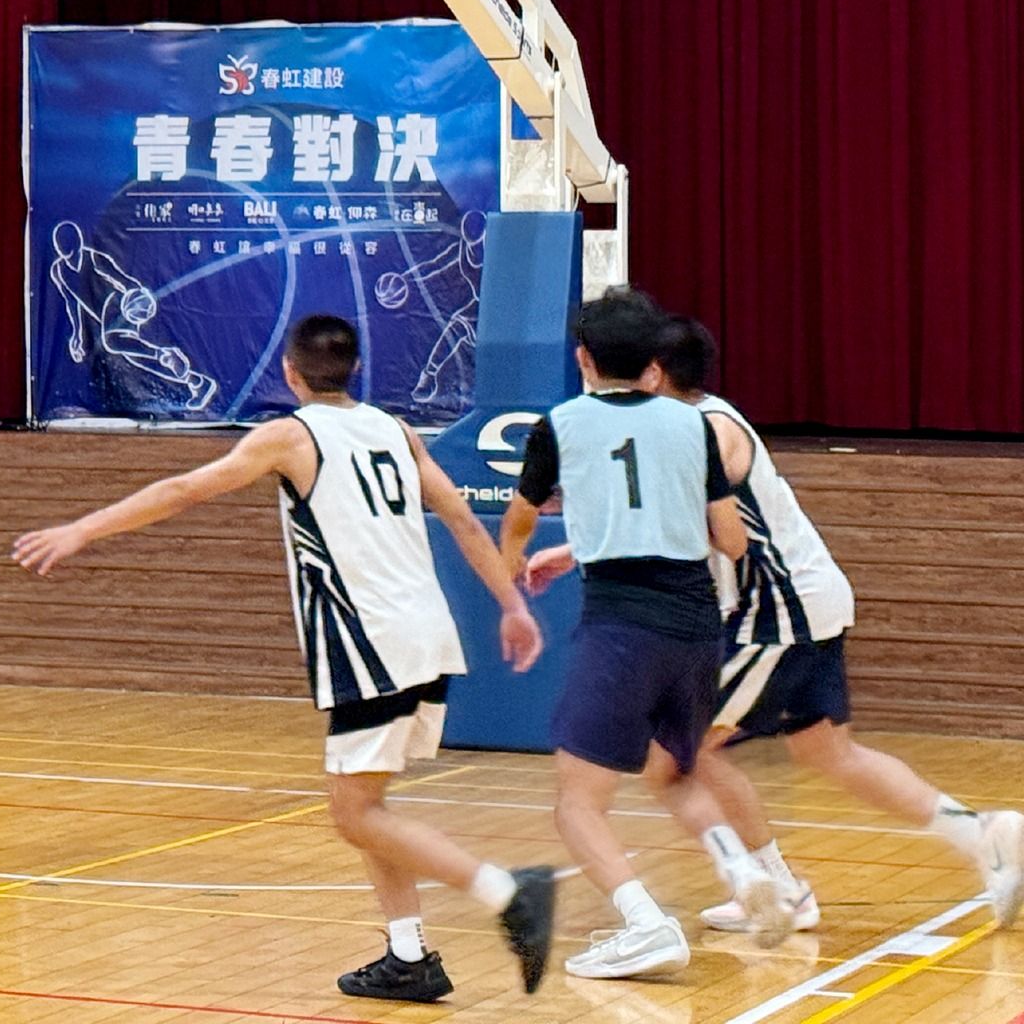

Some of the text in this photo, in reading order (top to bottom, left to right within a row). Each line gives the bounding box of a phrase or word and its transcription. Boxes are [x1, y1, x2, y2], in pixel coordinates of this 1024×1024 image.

[261, 67, 344, 89] 春虹建設
[133, 113, 439, 182] 青春對決
[351, 449, 406, 517] 10
[610, 437, 642, 509] 1
